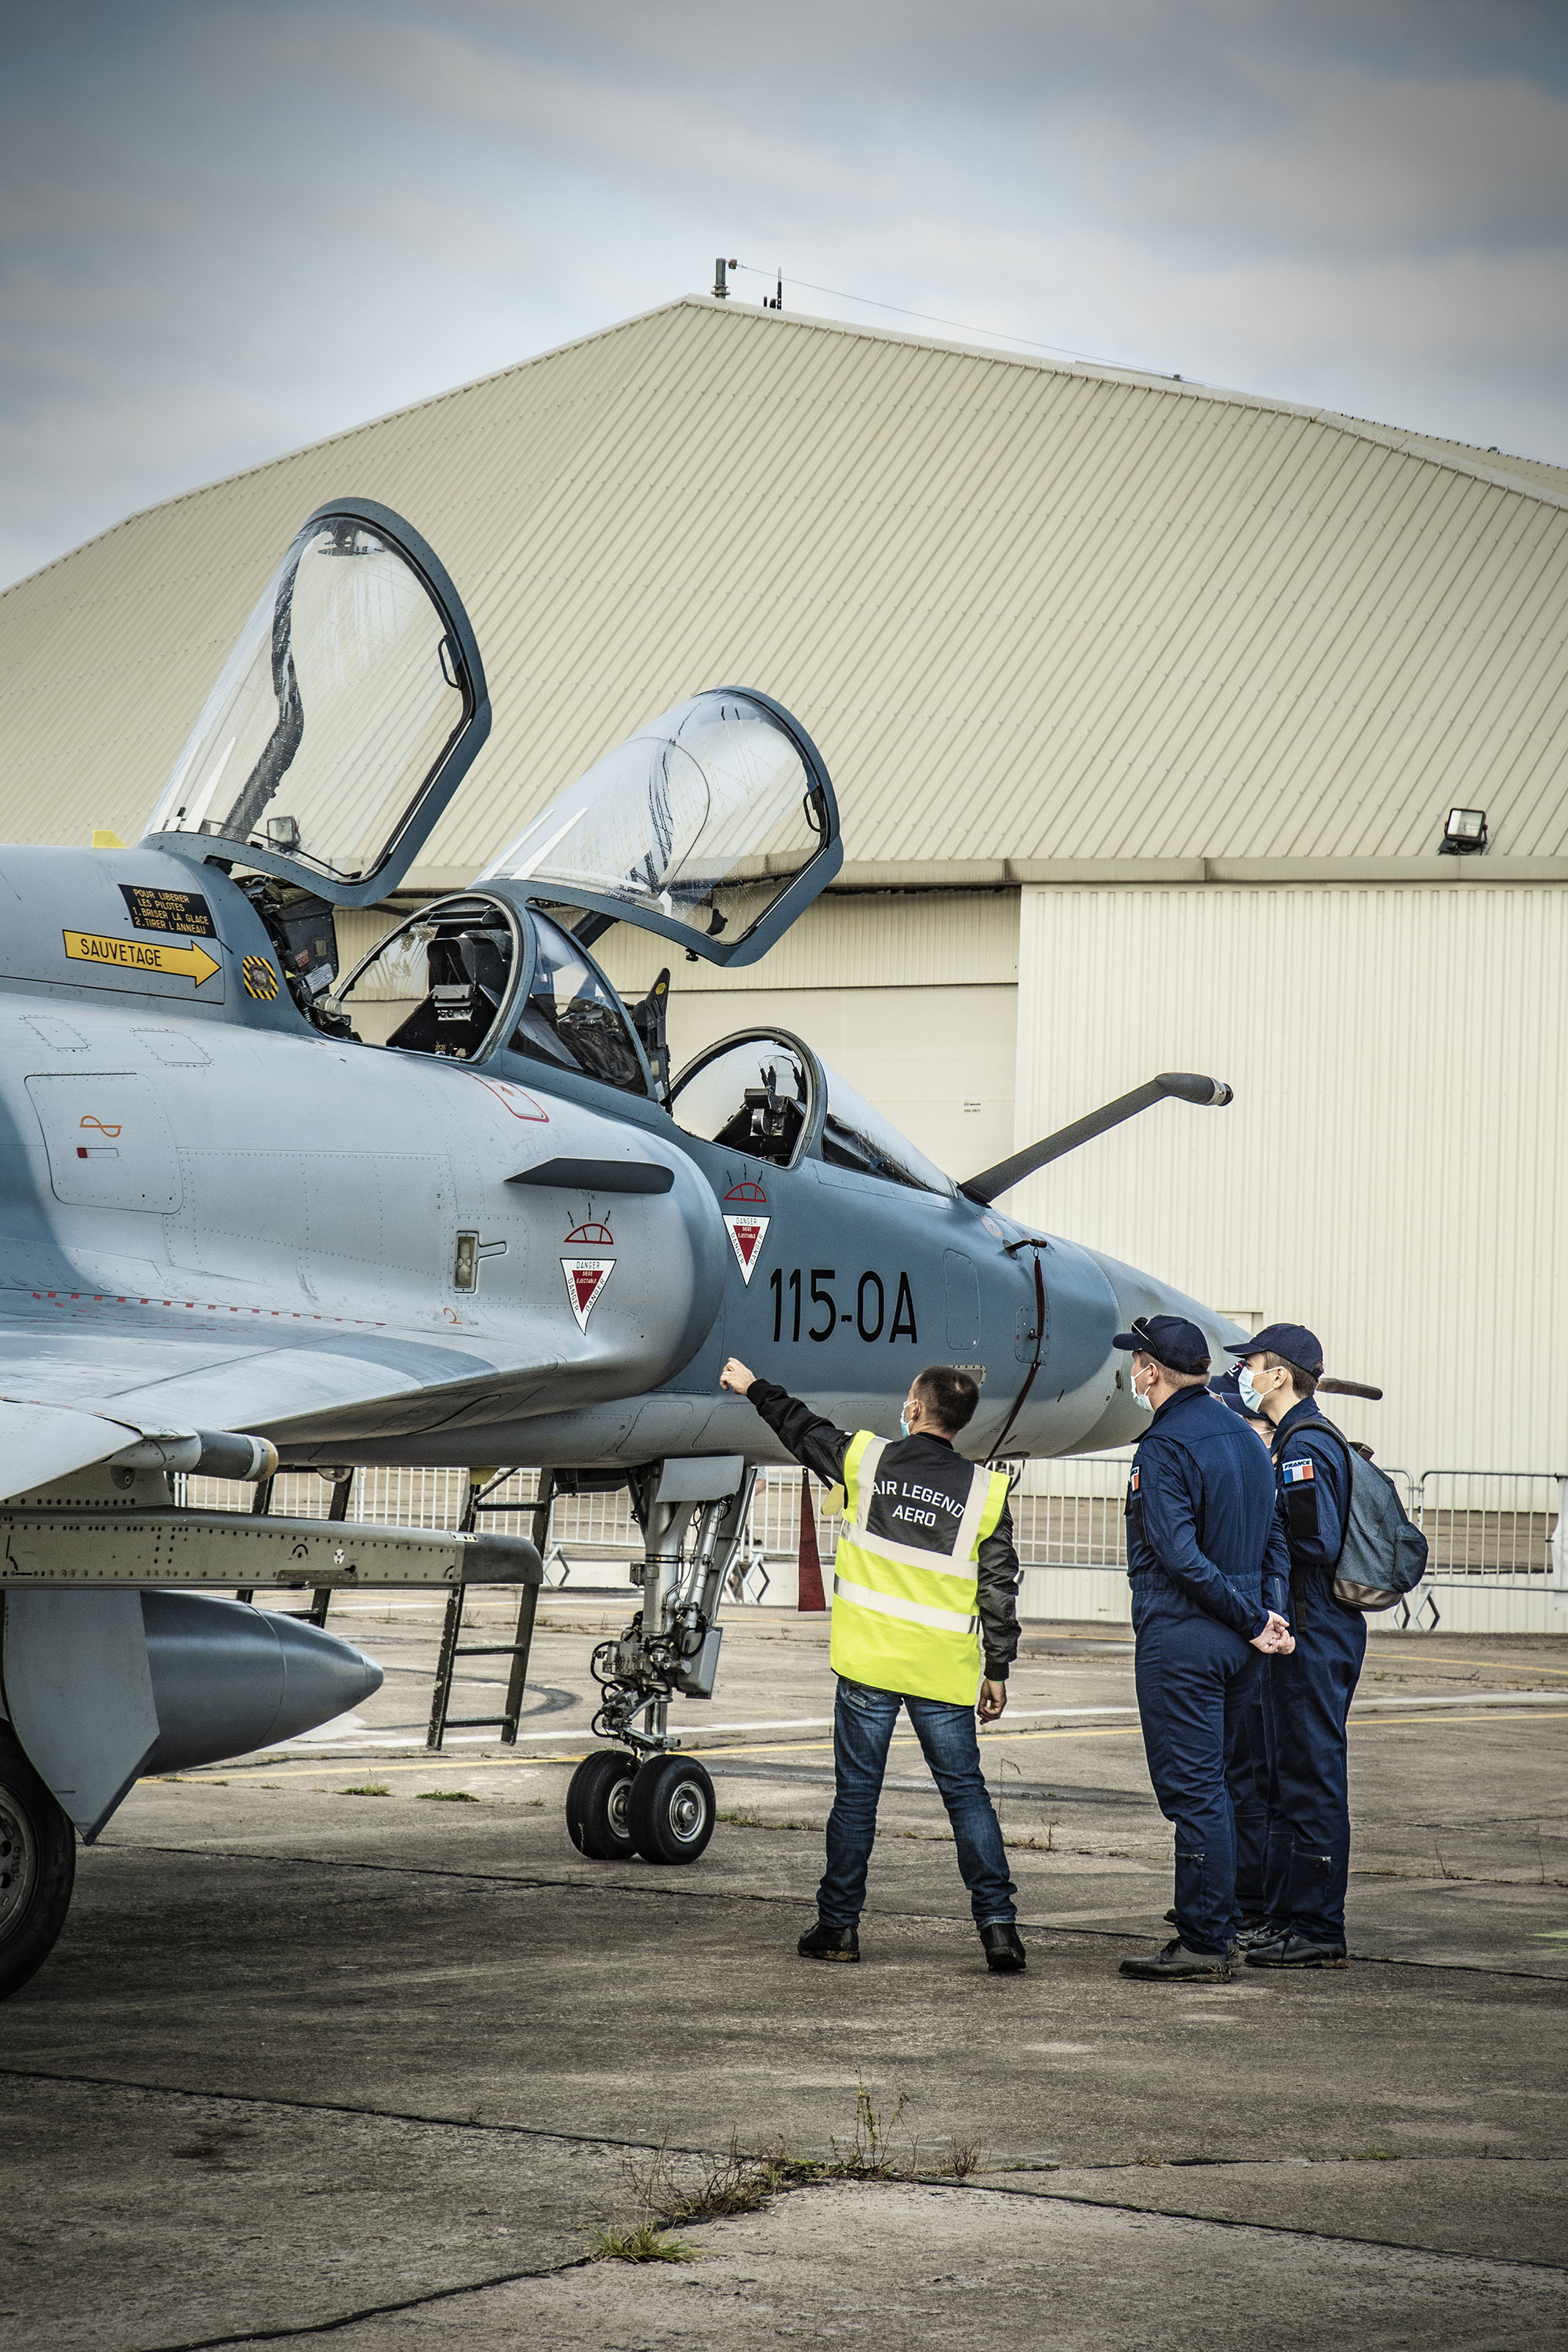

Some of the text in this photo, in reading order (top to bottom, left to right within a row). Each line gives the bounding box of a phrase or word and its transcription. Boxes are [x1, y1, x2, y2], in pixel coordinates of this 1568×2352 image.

[132, 888, 191, 903] POUR LIBERER
[137, 898, 186, 912] LES PILOTES
[171, 912, 183, 921] LA
[185, 913, 210, 925] GLACE
[81, 938, 162, 967] SAUVETAGE
[730, 1232, 745, 1265] DANGER
[750, 1233, 764, 1265] DANGER
[576, 1261, 601, 1269] DANGER
[568, 1277, 579, 1312] DANGER
[585, 1277, 605, 1312] DANGER
[1284, 1460, 1311, 1469] FRANCE
[872, 1480, 965, 1519] AIR LEGEND
[891, 1504, 936, 1527] AERO
